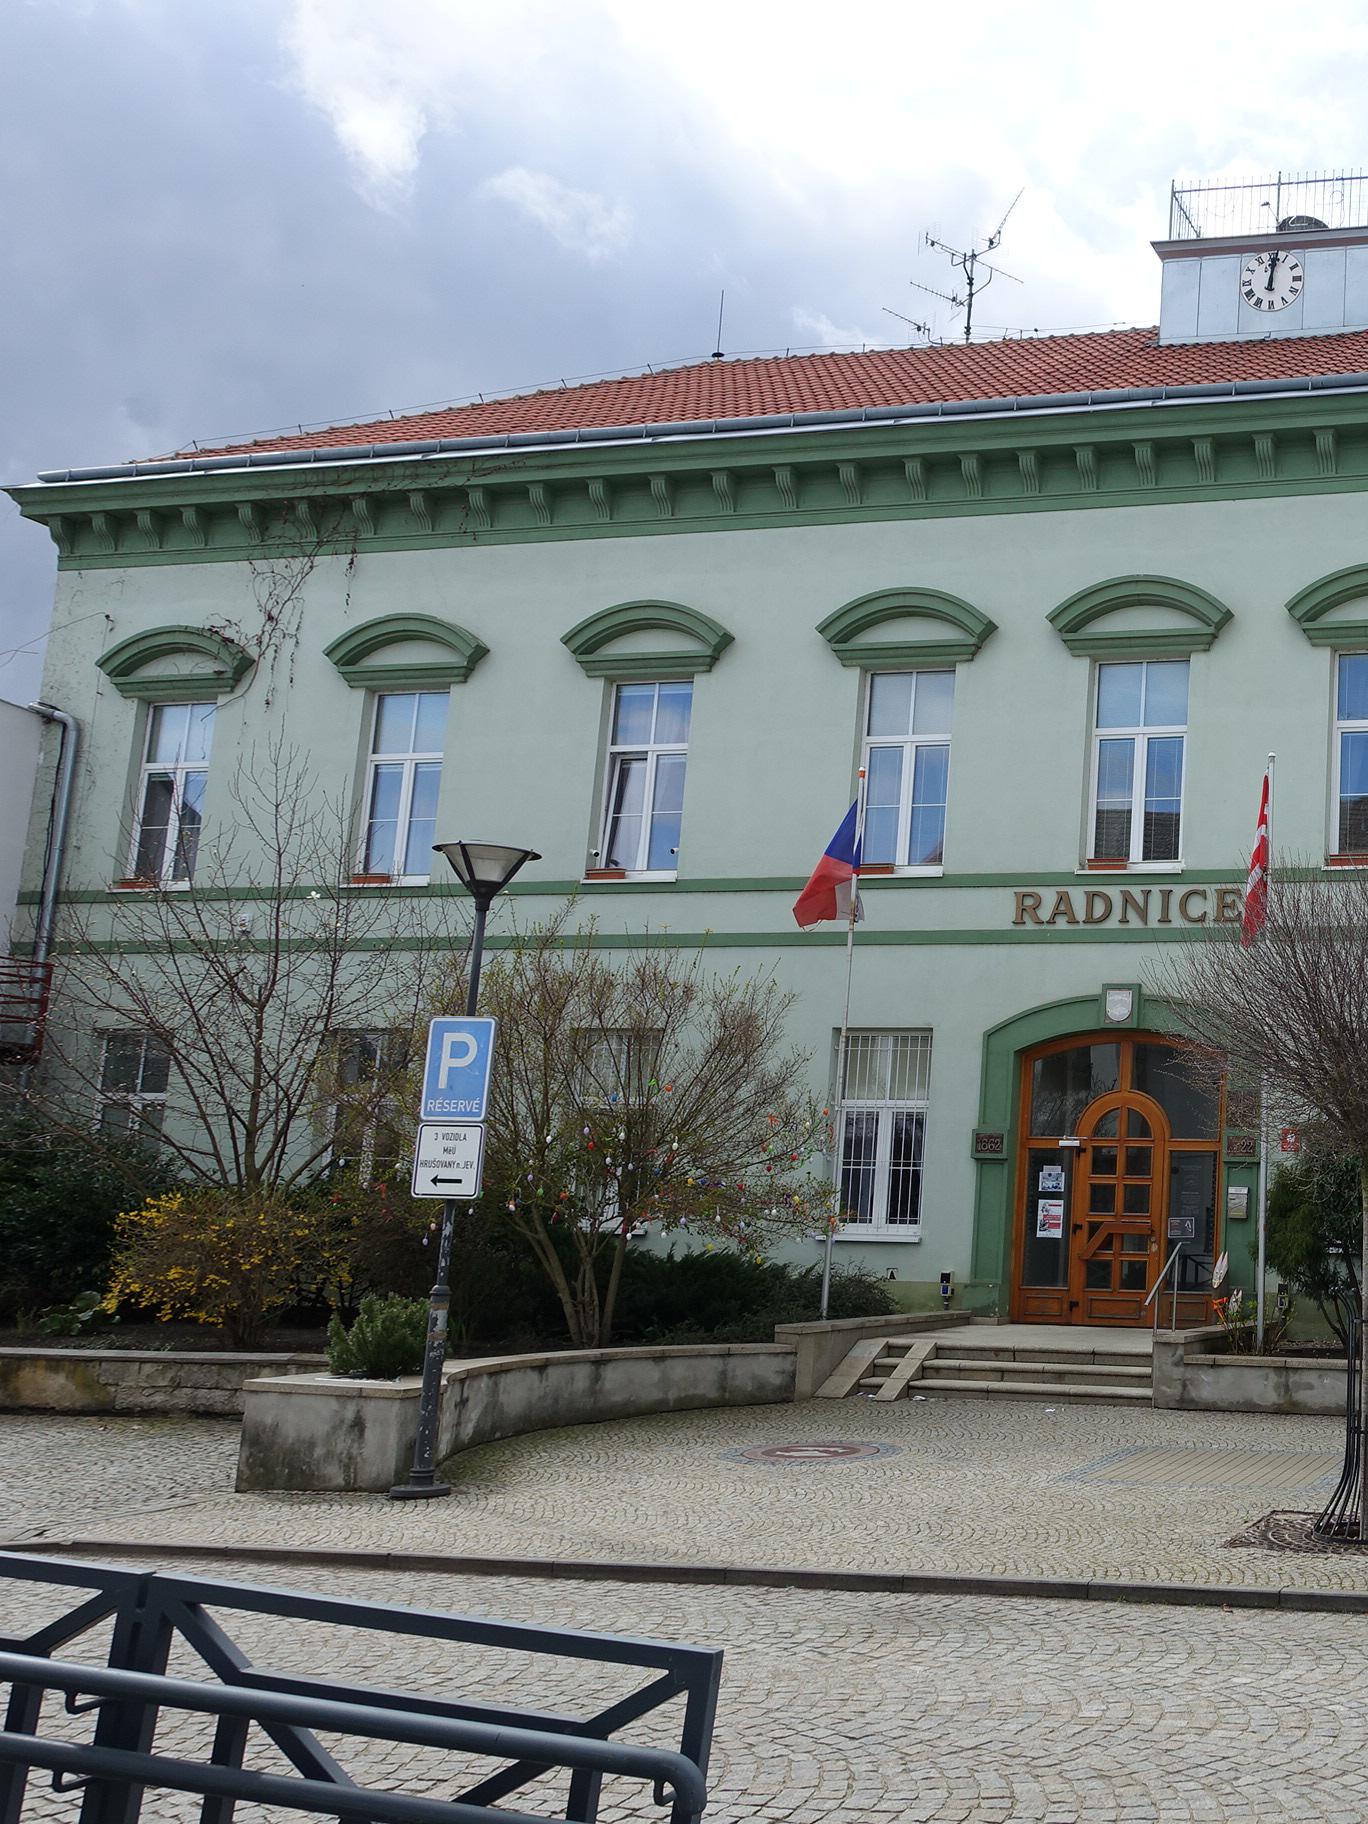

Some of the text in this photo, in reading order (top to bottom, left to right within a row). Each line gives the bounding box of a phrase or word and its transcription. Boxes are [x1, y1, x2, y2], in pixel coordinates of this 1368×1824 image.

[1012, 888, 1243, 926] RADNICE
[437, 1032, 479, 1089] P
[426, 1098, 481, 1113] RÉSERVÉ
[433, 1132, 467, 1141] 3 VOZIDLA
[419, 1157, 456, 1169] HRUŠOVANY
